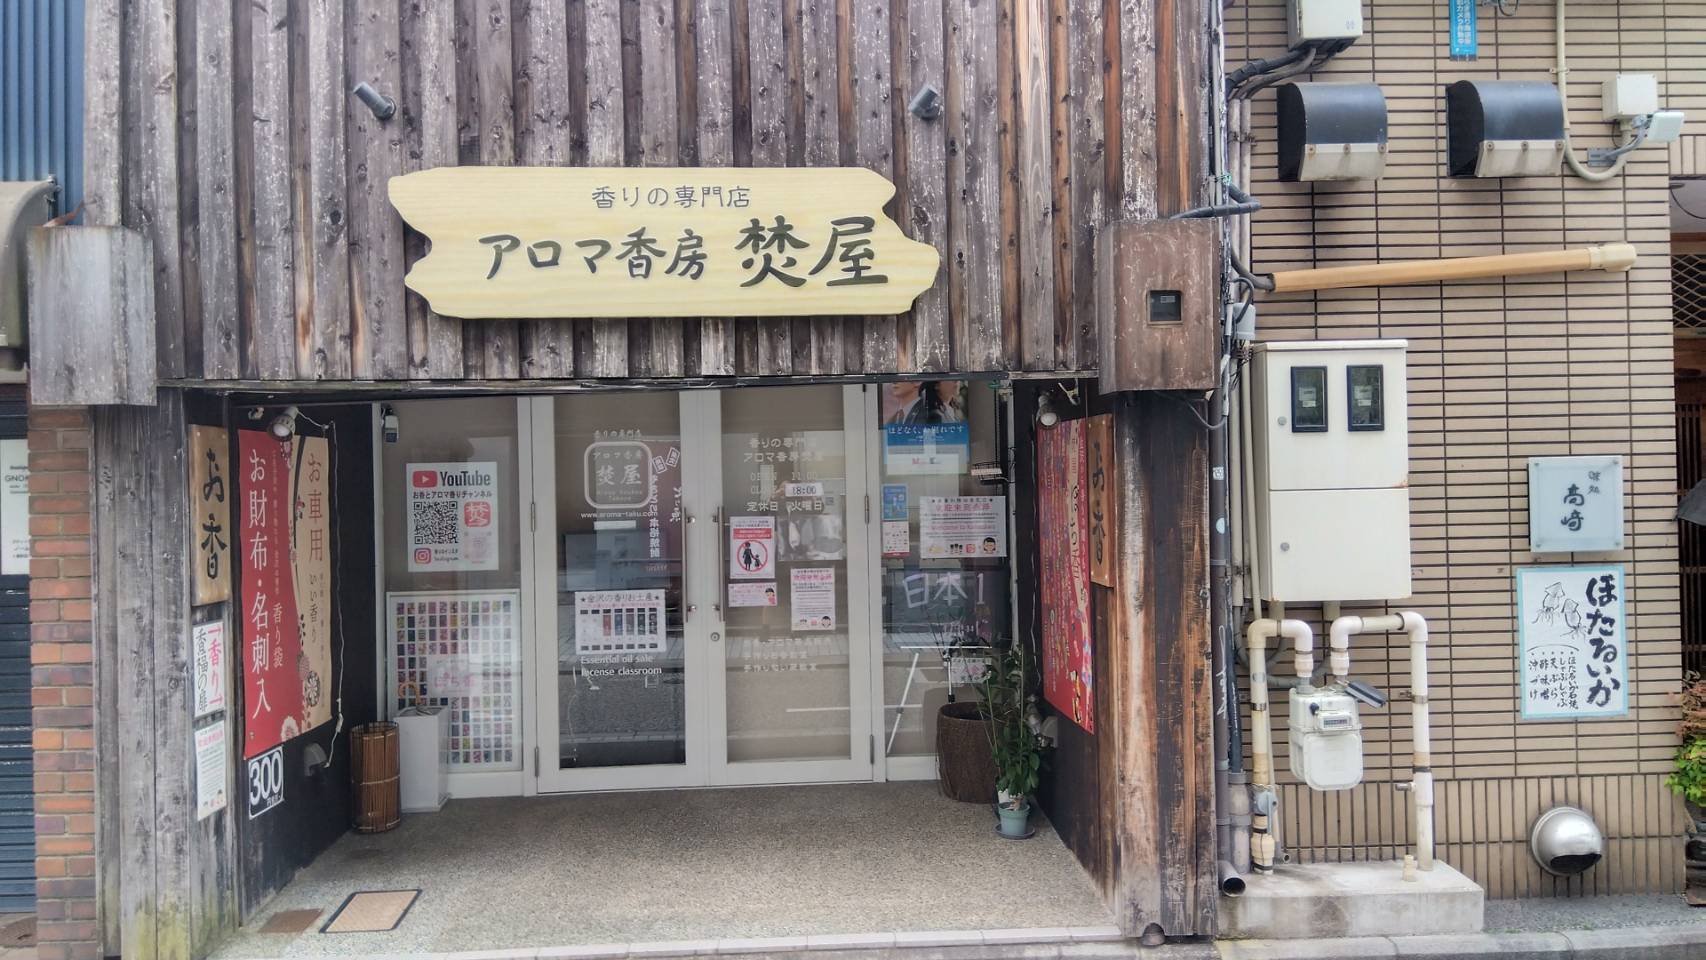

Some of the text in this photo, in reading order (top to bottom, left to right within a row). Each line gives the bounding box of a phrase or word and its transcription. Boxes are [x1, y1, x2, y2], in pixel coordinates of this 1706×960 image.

[591, 186, 751, 208] 香りの専門店
[478, 215, 889, 288] アロマ香房 焚屋
[308, 453, 323, 562] お車用
[440, 470, 491, 486] YouTube
[746, 500, 823, 512] 定休日 火曜日
[793, 485, 817, 495] 18:00
[201, 448, 228, 580] お香
[249, 448, 272, 720] お財布・名刺入
[272, 603, 284, 668] 香り袋
[1585, 574, 1621, 708] ほたるいか
[618, 666, 662, 676] classroom
[250, 751, 281, 806] 300
